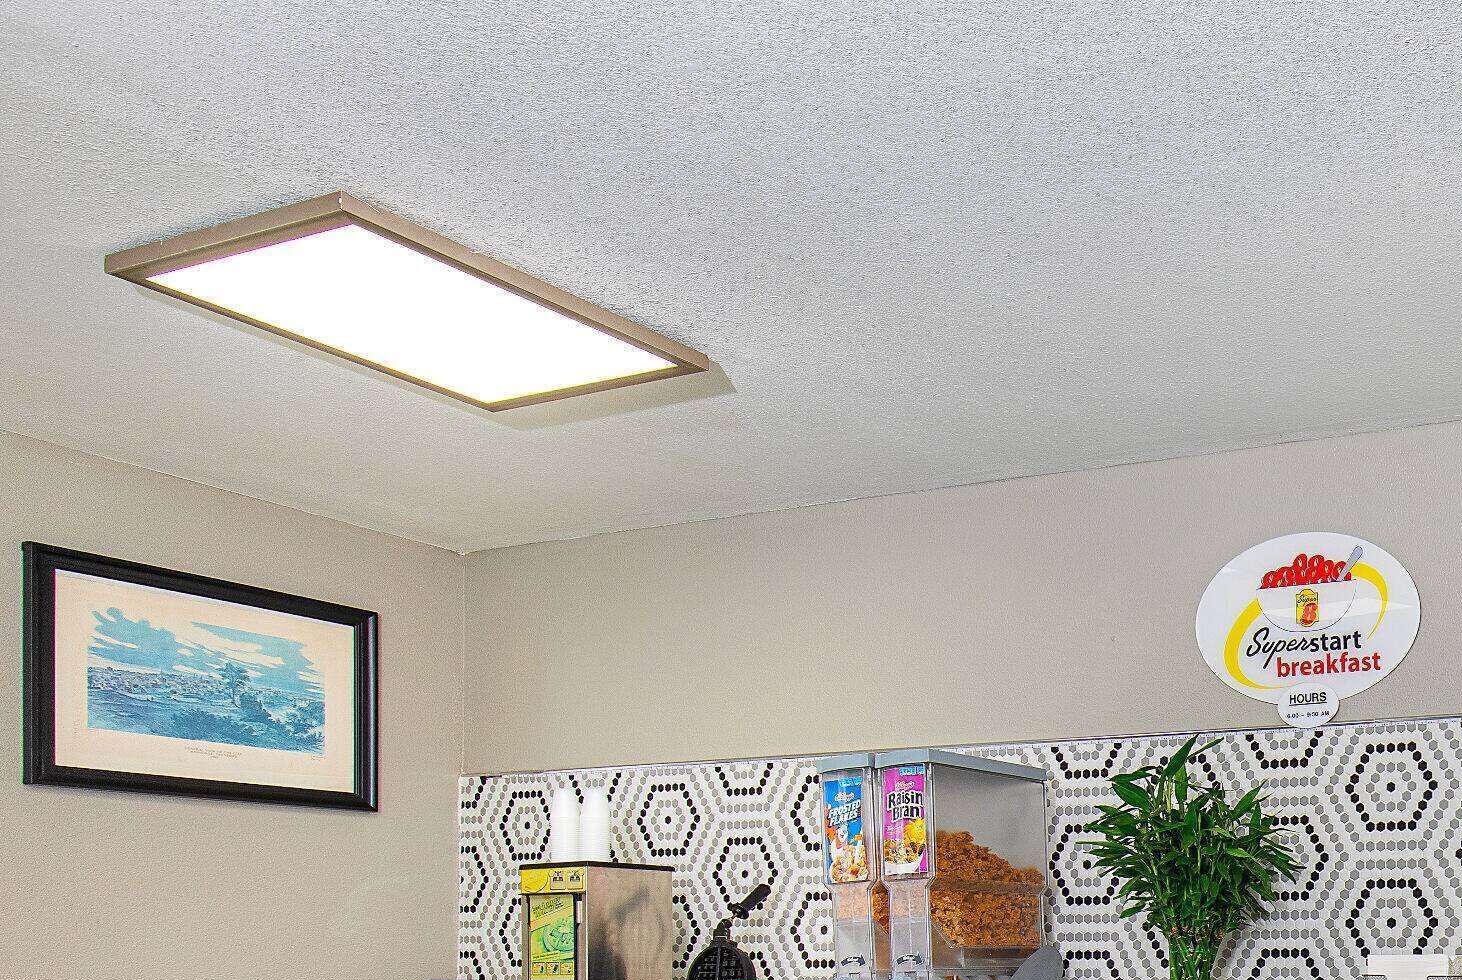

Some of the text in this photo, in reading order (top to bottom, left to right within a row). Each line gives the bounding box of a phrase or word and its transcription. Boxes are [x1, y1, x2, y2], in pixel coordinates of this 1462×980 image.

[1246, 627, 1362, 669] Superstart
[1276, 652, 1381, 678] breakfast
[1289, 691, 1327, 704] HOURS
[829, 799, 861, 819] FROSTED
[888, 791, 923, 809] Raisin
[893, 804, 920, 821] Bran
